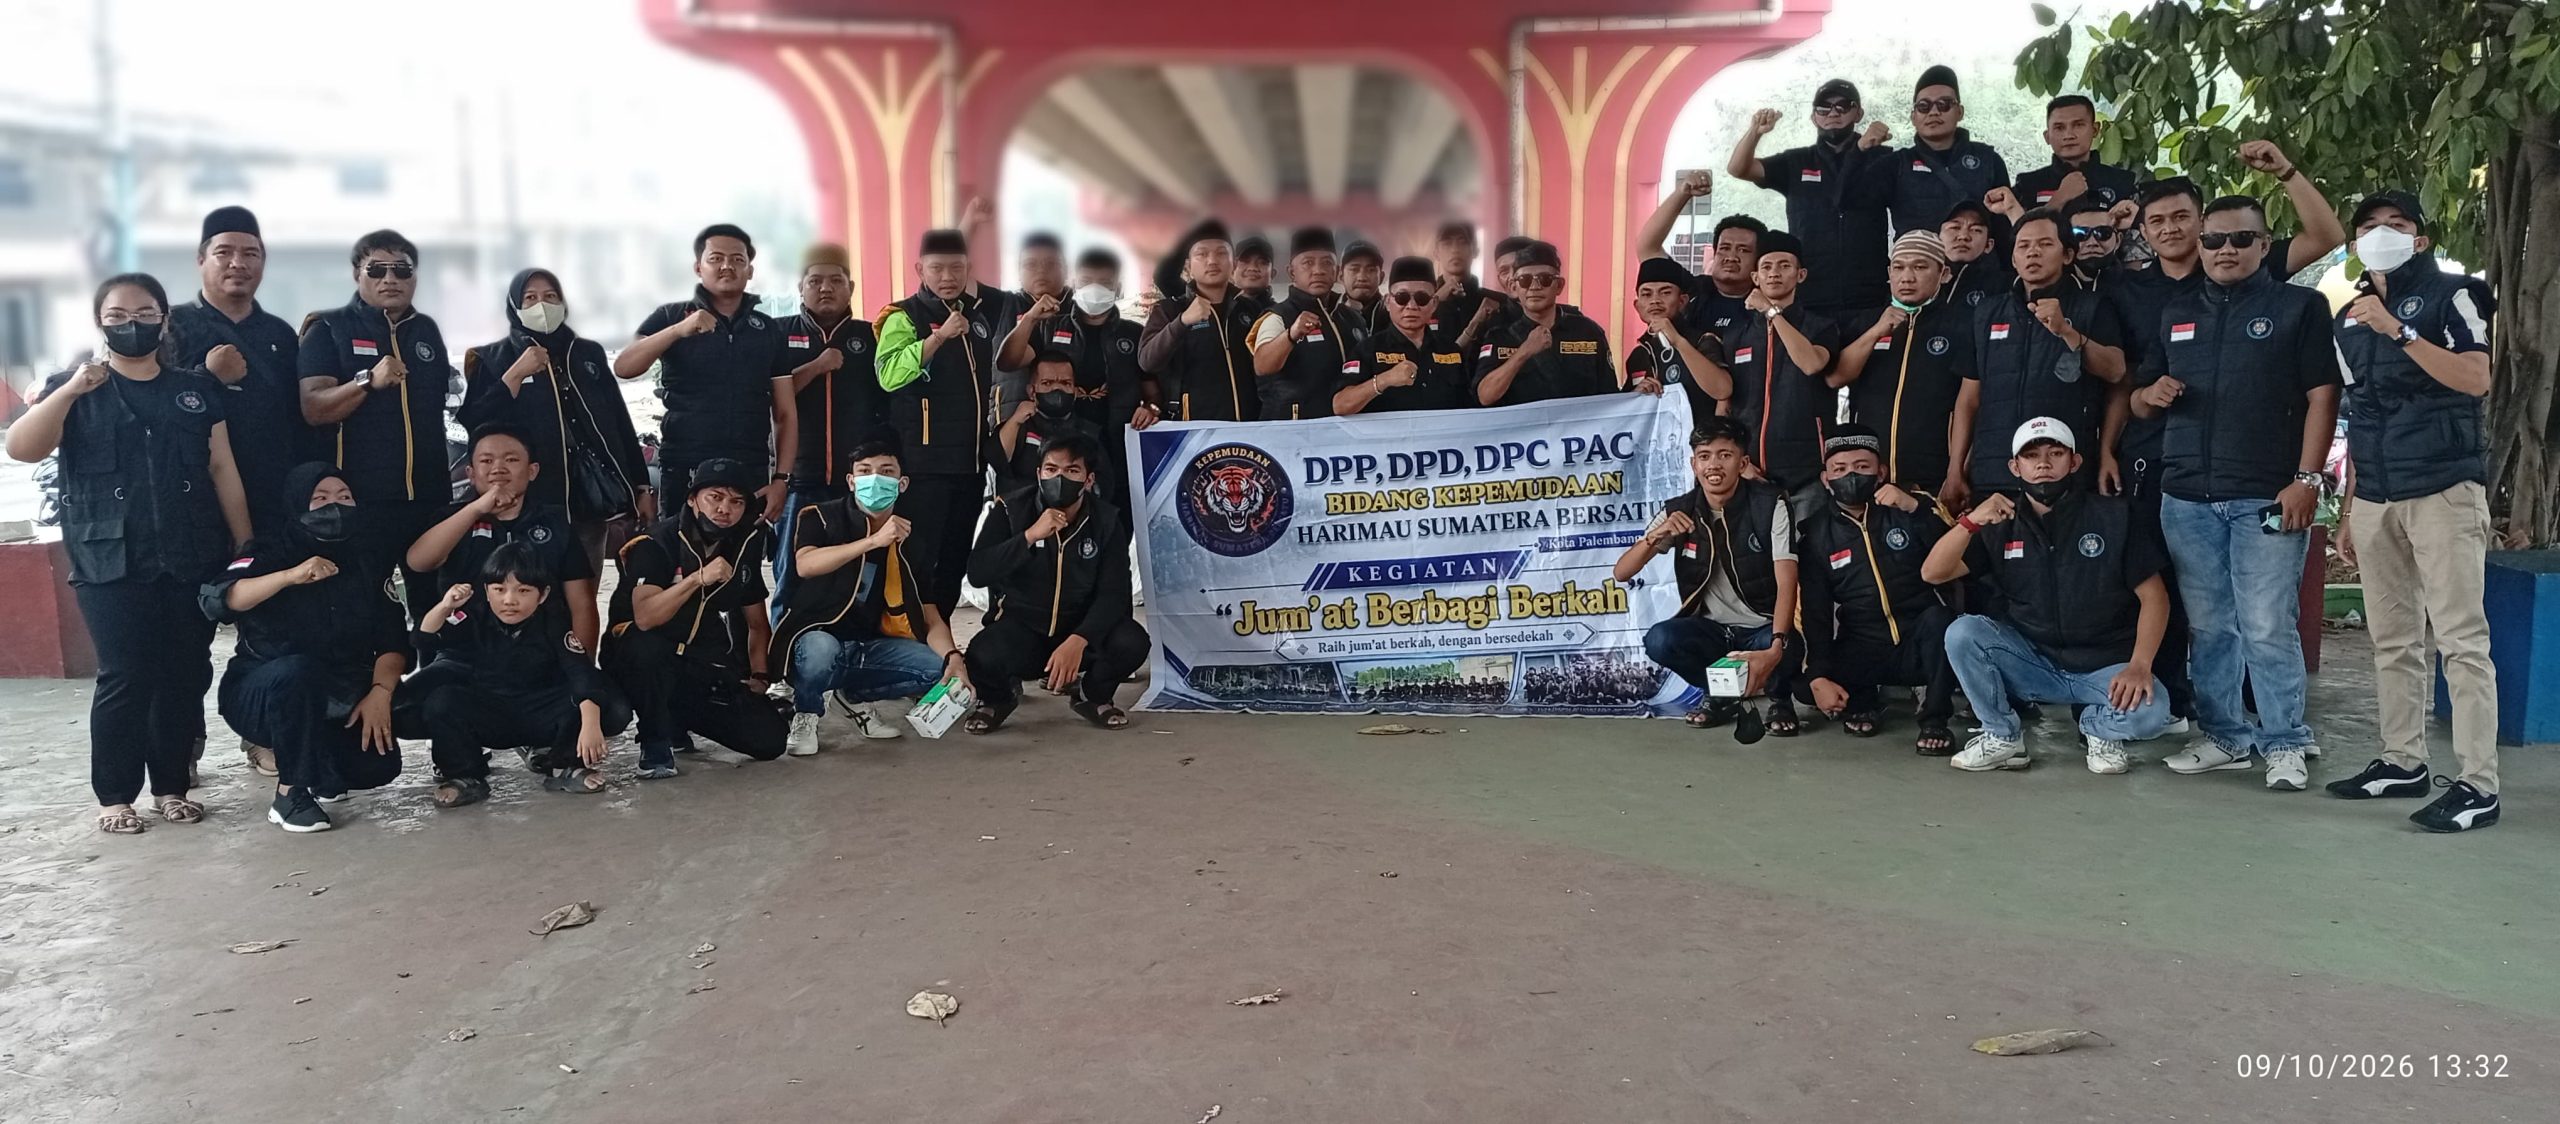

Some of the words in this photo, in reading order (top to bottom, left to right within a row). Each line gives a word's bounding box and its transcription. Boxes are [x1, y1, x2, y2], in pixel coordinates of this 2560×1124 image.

[1195, 447, 1271, 470] KEPEMUDAAN
[1561, 432, 1634, 466] PAC
[1325, 487, 1430, 515] BIDANG
[1432, 470, 1623, 509] KEPEMUDAAN
[1297, 520, 1412, 545] HARIMAU
[1417, 509, 1550, 537] SUMATERA
[1549, 537, 1576, 550] Kota
[1348, 558, 1498, 582] KEGIATAN
[1365, 585, 1501, 631] Berbagi
[1318, 640, 1346, 653] Raih
[1390, 635, 1436, 650] berkah,
[1438, 634, 1482, 648] dengan
[1485, 629, 1554, 645] bersedekah
